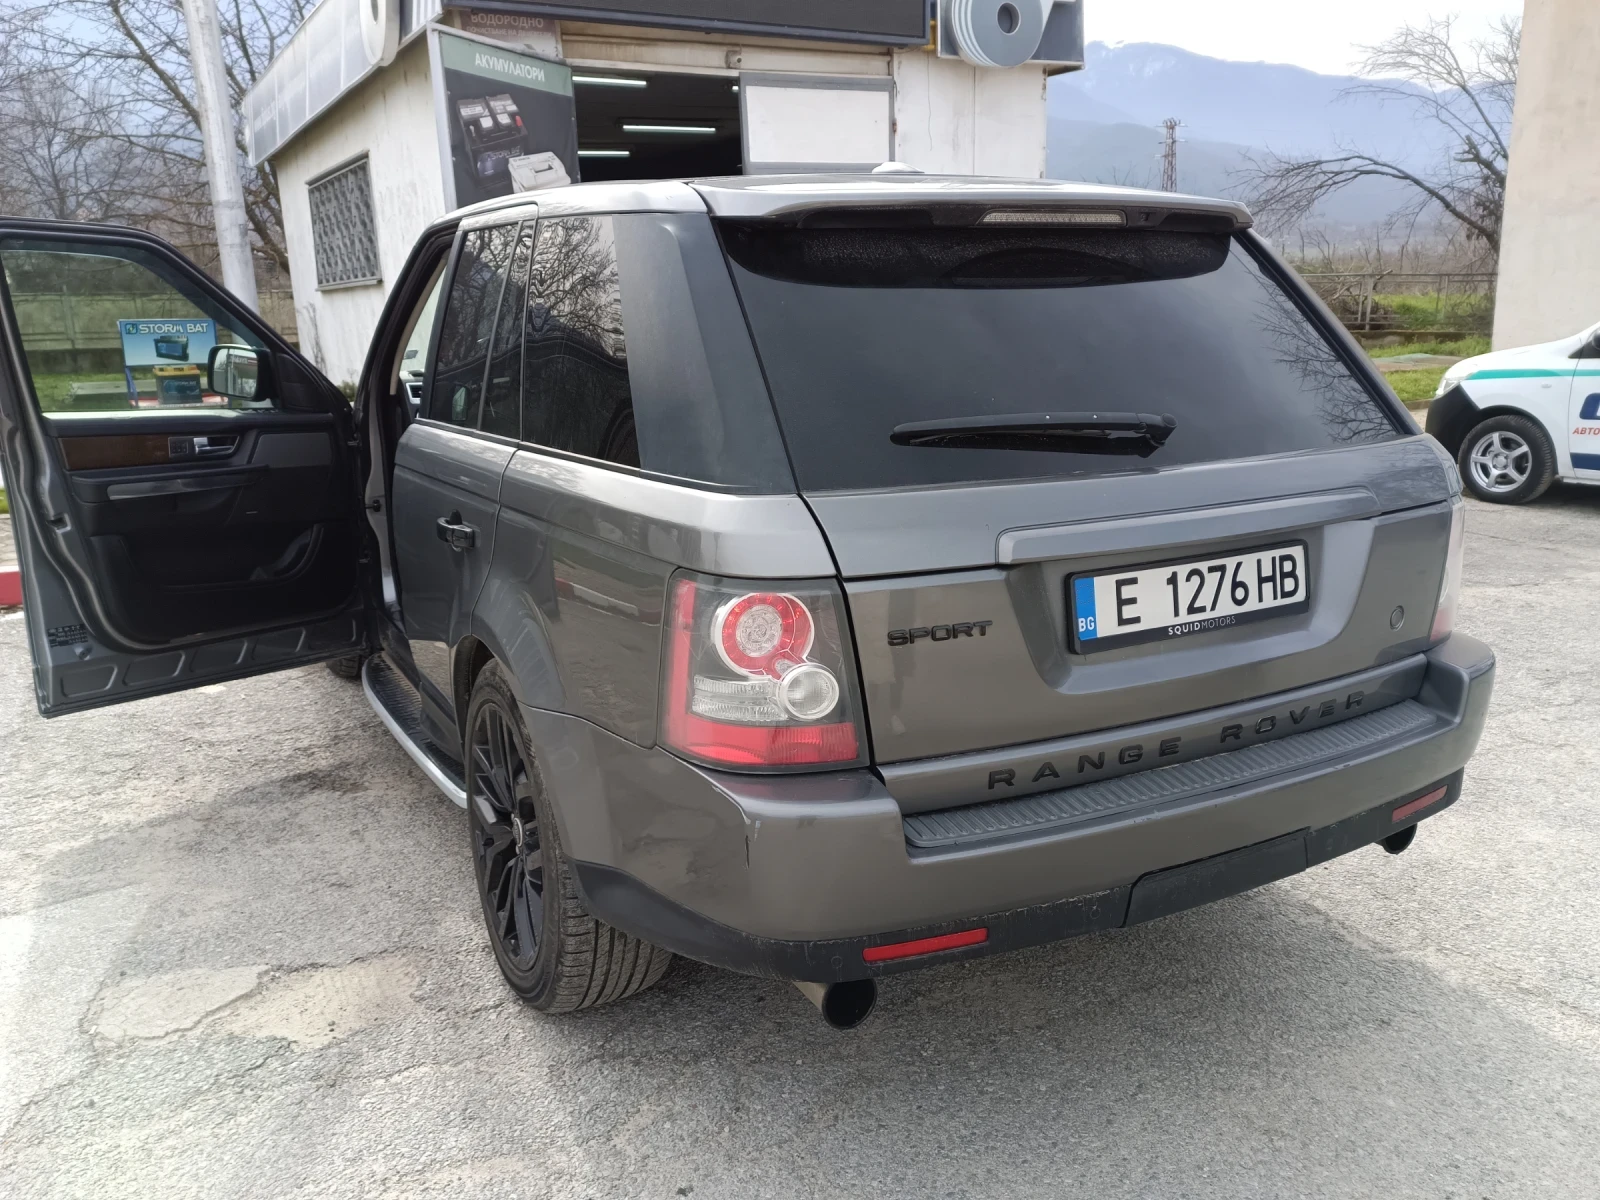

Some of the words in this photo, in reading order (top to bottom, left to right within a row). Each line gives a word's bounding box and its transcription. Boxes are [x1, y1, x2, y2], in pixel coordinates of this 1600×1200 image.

[472, 13, 544, 28] ВОДОРОДНО
[475, 53, 545, 81] АКУМУЛАТОРИ
[138, 323, 184, 334] STORM
[186, 322, 209, 333] BAT
[1115, 576, 1142, 627] E
[1166, 561, 1250, 618] 1276
[1256, 553, 1300, 603] HB
[887, 620, 993, 647] SPORT
[1078, 616, 1095, 632] BG
[987, 736, 1182, 790] RANGE
[1219, 690, 1365, 744] ROVER
